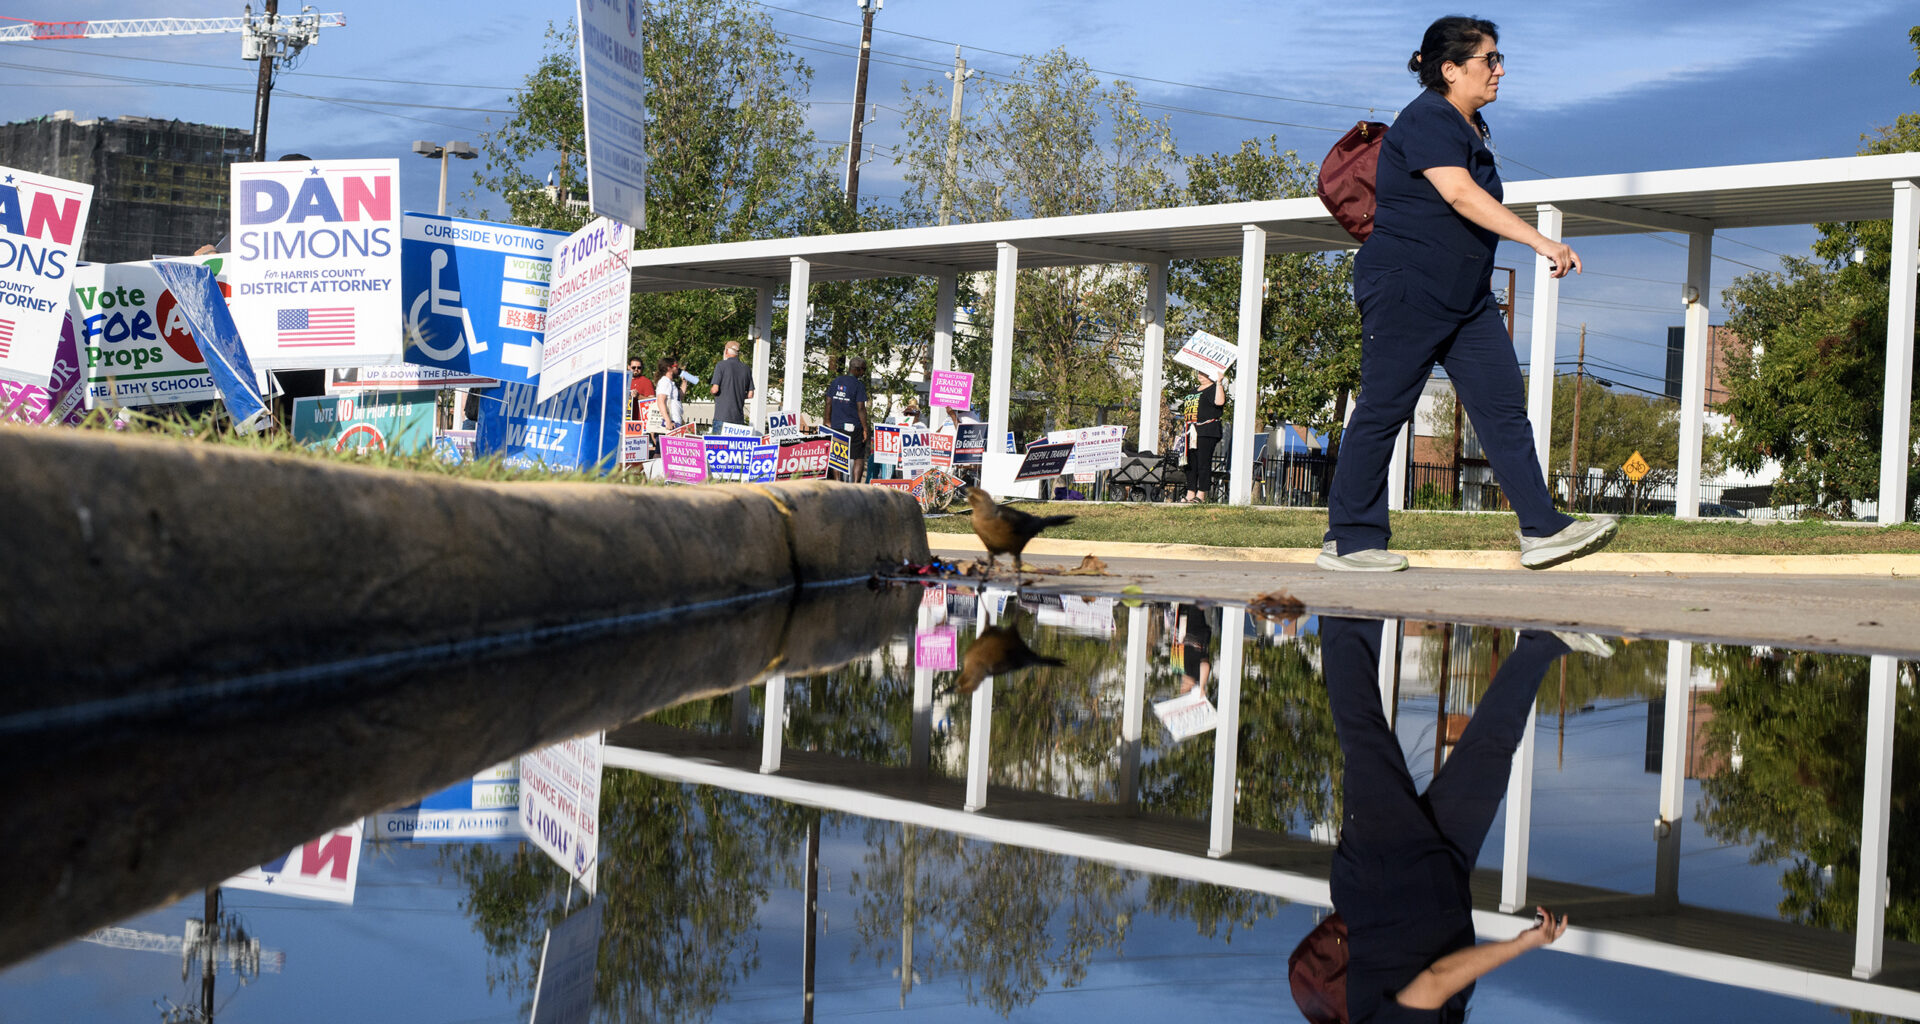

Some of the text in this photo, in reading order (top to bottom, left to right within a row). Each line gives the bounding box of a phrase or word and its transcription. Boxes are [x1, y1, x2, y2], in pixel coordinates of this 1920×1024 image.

[240, 175, 391, 225] DAN
[240, 228, 391, 261] SIMONS
[424, 224, 544, 250] CURBSIDE VOTING
[264, 269, 365, 280] For HARRIS COUNTY
[525, 272, 538, 281] LA
[550, 248, 629, 307] DISTANCE MARKER
[240, 279, 392, 295] DISTRICT ATTORNEY
[76, 286, 146, 310] Vote
[82, 310, 156, 345] FOR
[84, 346, 163, 370] Props
[367, 368, 474, 379] UP & DOWN THE BALLO
[152, 376, 214, 392] SCHOOLS
[936, 378, 968, 387] JERALYNN
[940, 386, 963, 394] MANOR
[314, 408, 333, 423] VOTE
[336, 399, 354, 422] NO
[389, 404, 396, 417] A
[406, 402, 412, 417] B
[628, 424, 641, 432] NO
[770, 413, 797, 428] DAN
[507, 423, 568, 452] WALZ
[724, 426, 751, 436] TRUMP
[770, 426, 798, 437] SIMONS
[902, 432, 930, 447] DAN
[931, 440, 951, 450] ING
[665, 445, 701, 458] JERALYNN
[790, 445, 825, 457] Jolanda
[831, 441, 848, 459] OX
[903, 447, 930, 458] SIMONS
[671, 456, 698, 466] MANOR
[751, 459, 776, 474] GO
[778, 455, 828, 473] JONES
